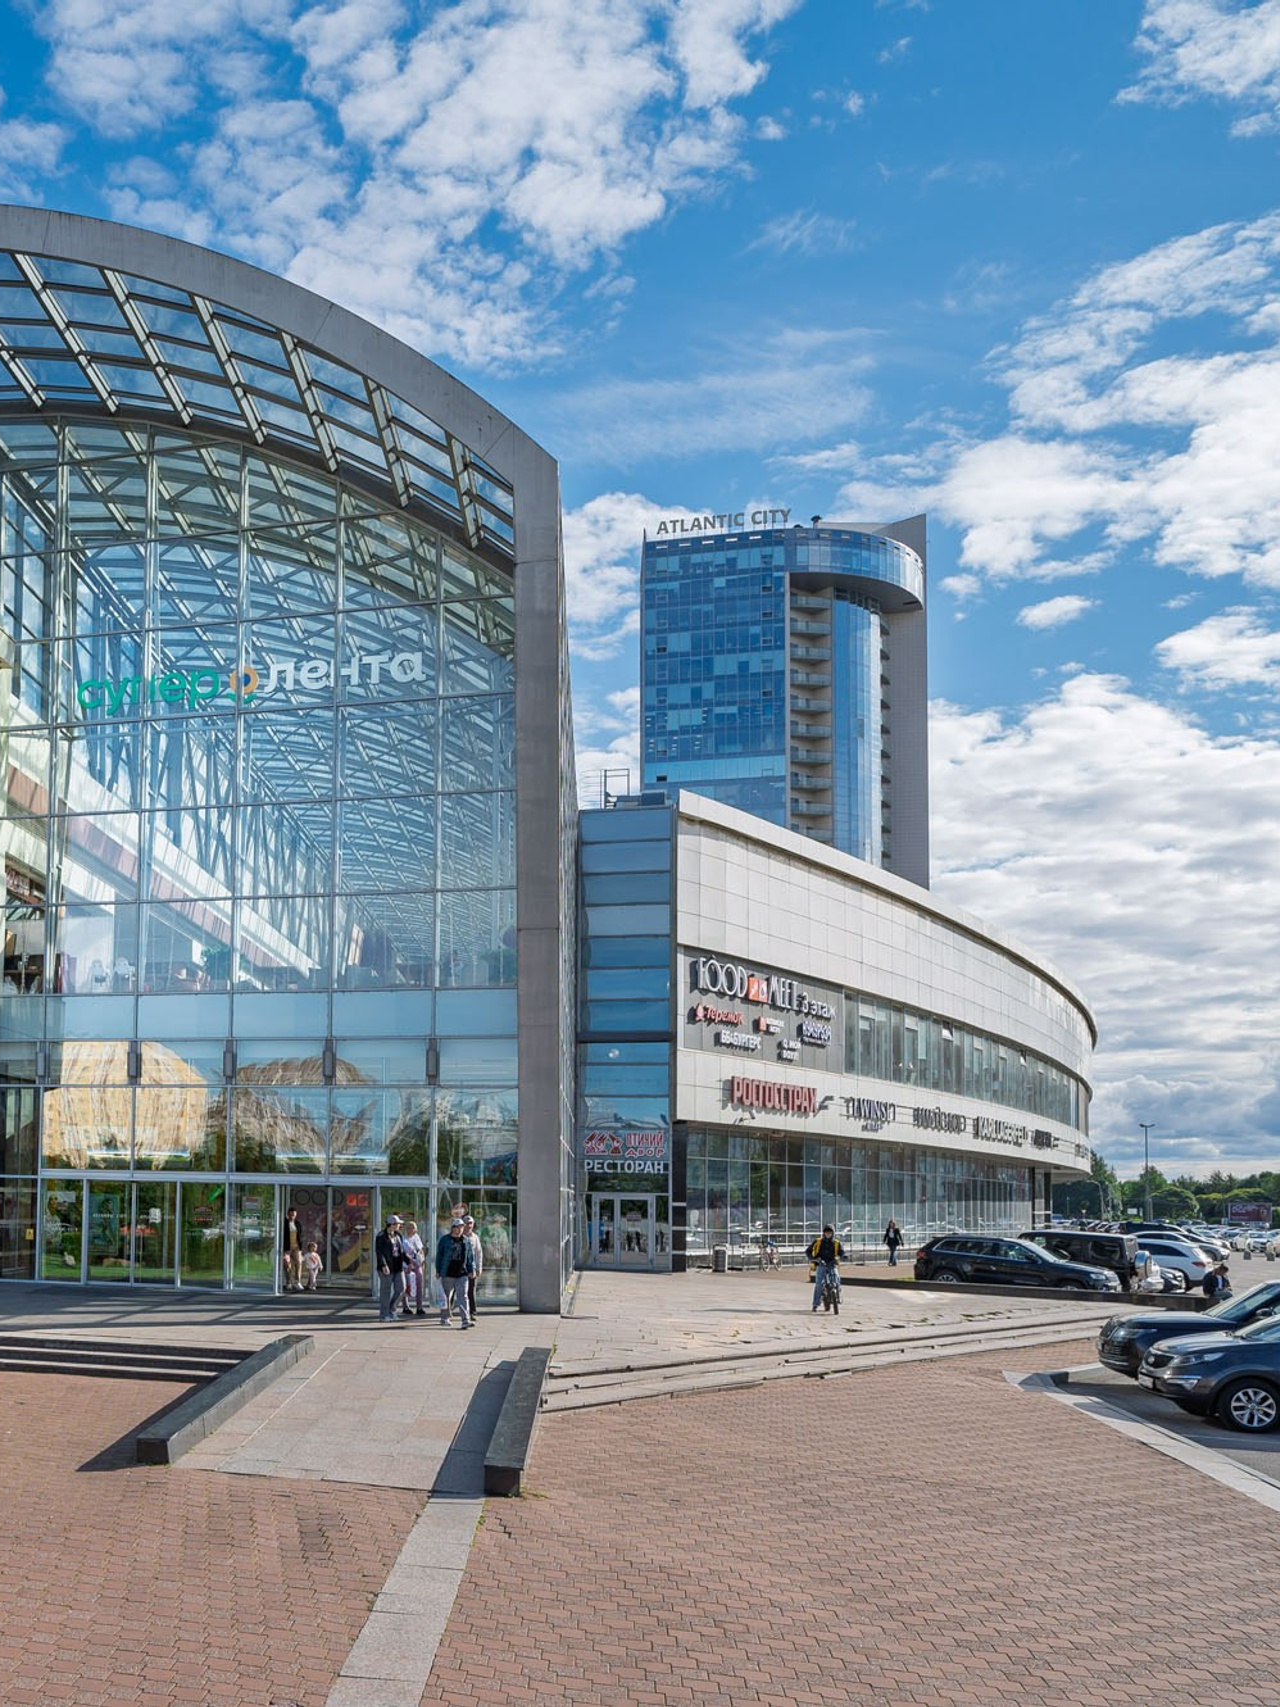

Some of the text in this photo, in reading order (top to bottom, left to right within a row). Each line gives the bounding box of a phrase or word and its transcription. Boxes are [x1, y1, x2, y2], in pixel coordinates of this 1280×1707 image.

[657, 509, 791, 534] ATLANTIC CITY
[265, 651, 426, 694] лента
[698, 956, 799, 1011] FOOD MEET
[731, 1076, 817, 1113] РОСГОССТРАХ
[626, 1130, 664, 1147] ПТИЧИЙ
[625, 1148, 665, 1158] ДВОР
[584, 1159, 664, 1174] РЕСТОРАН
